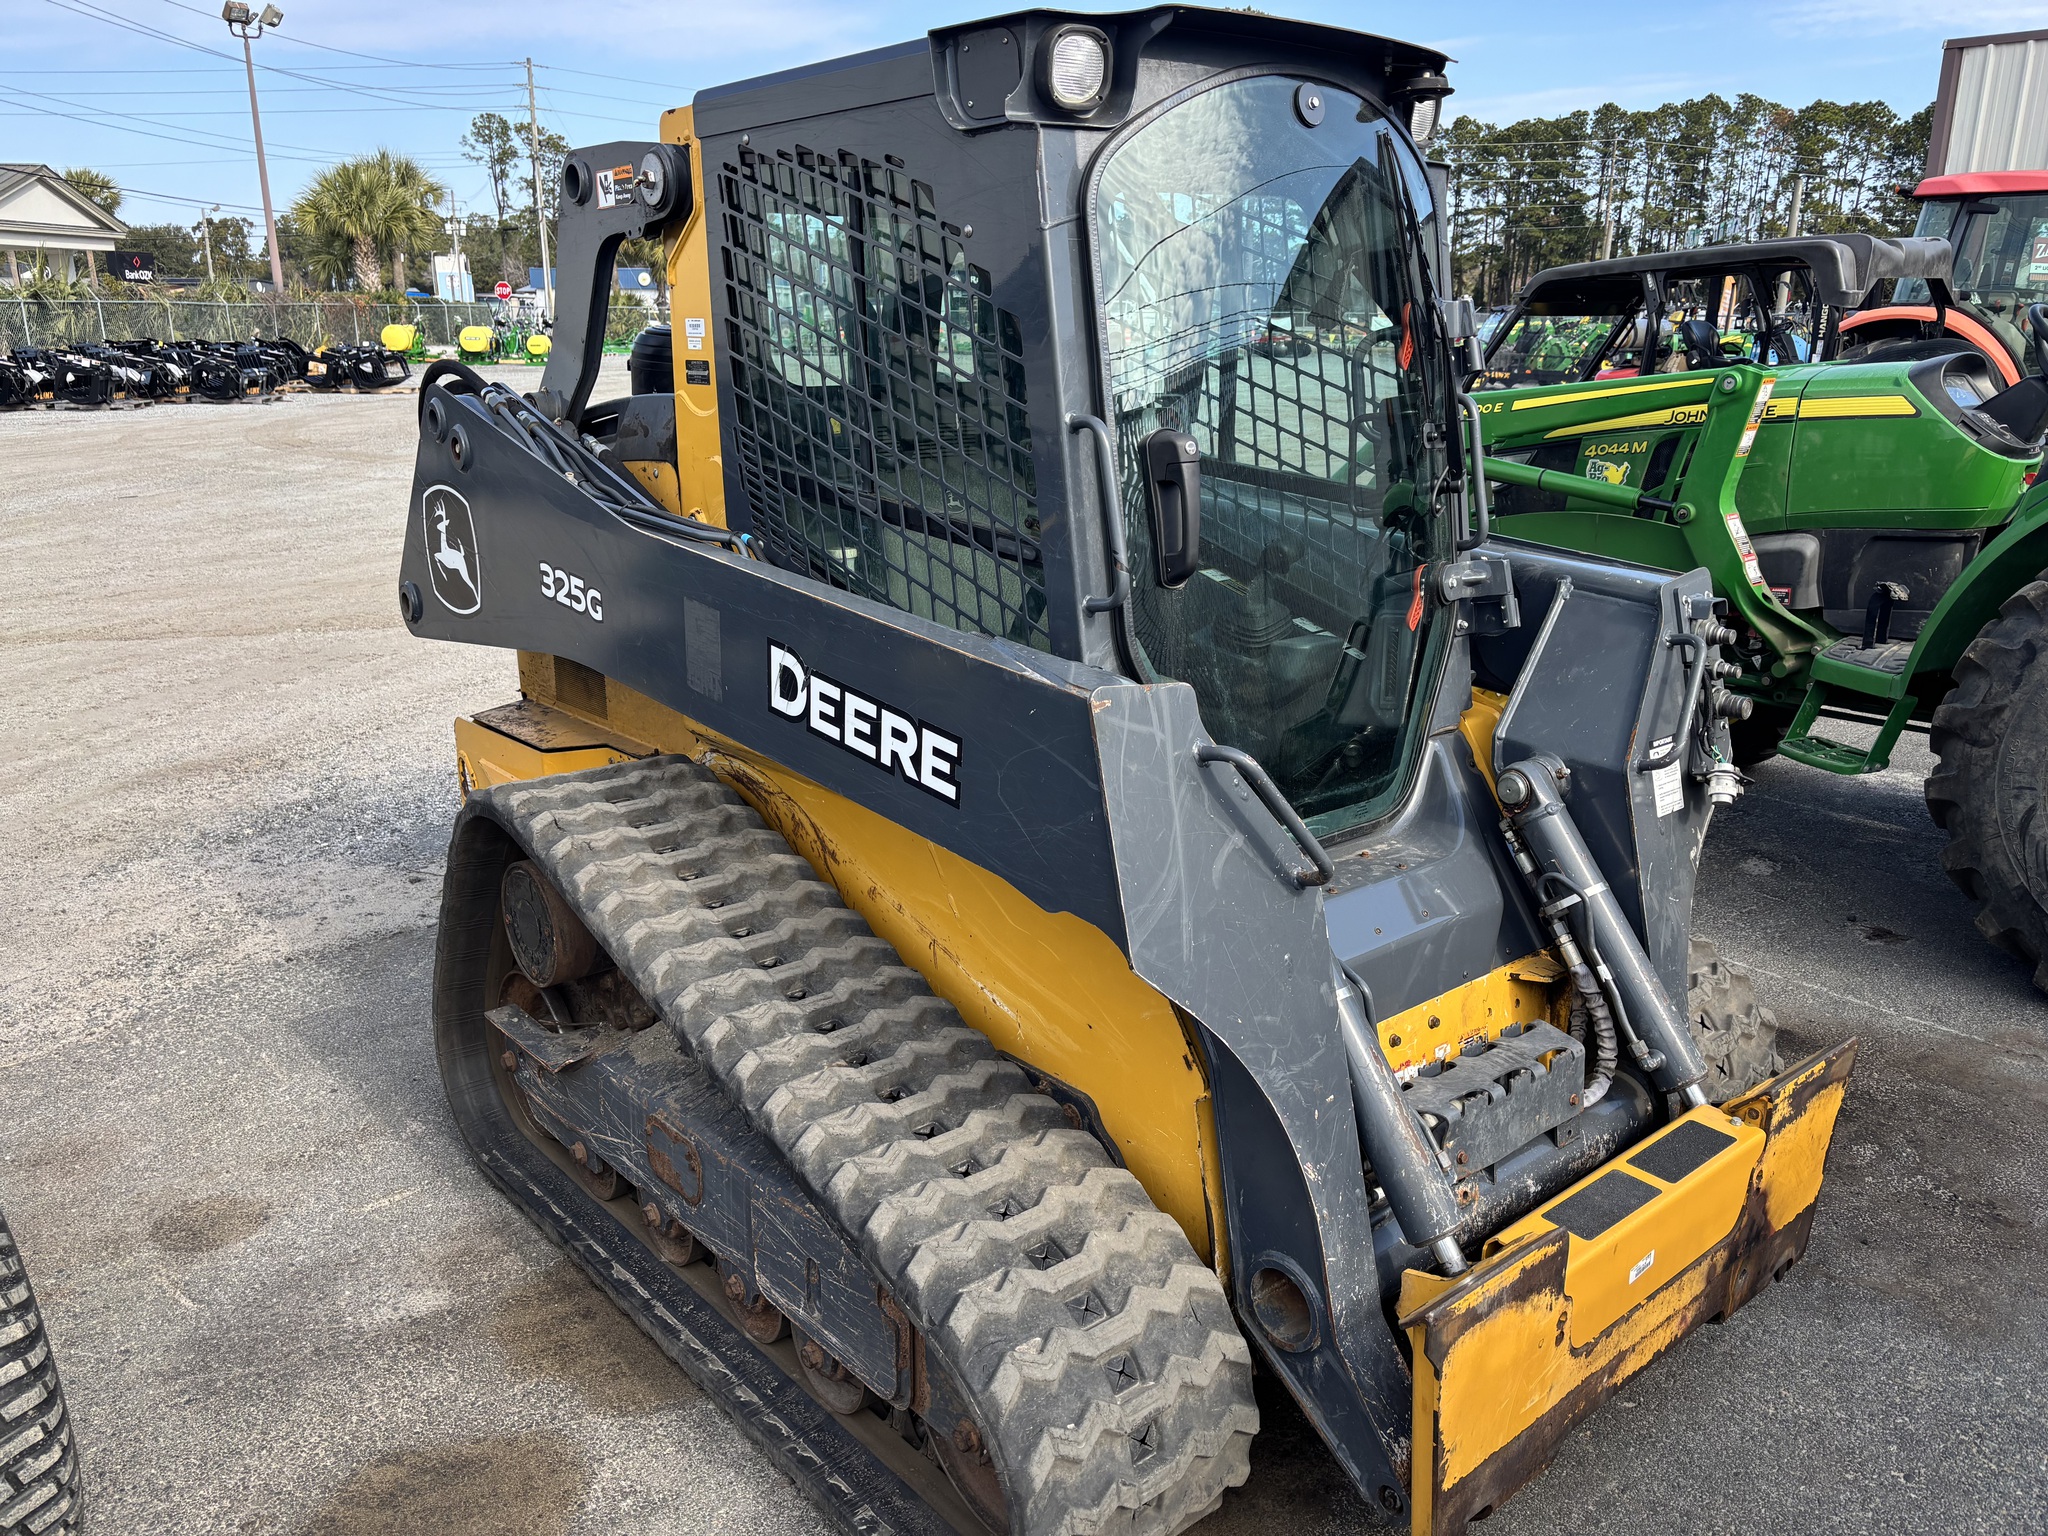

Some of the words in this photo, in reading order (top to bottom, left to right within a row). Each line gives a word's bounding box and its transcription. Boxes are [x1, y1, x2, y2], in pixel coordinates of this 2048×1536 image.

[495, 286, 511, 295] STOP
[1664, 410, 1708, 424] JOHN
[539, 562, 603, 621] 325G
[770, 644, 959, 801] DEERE
